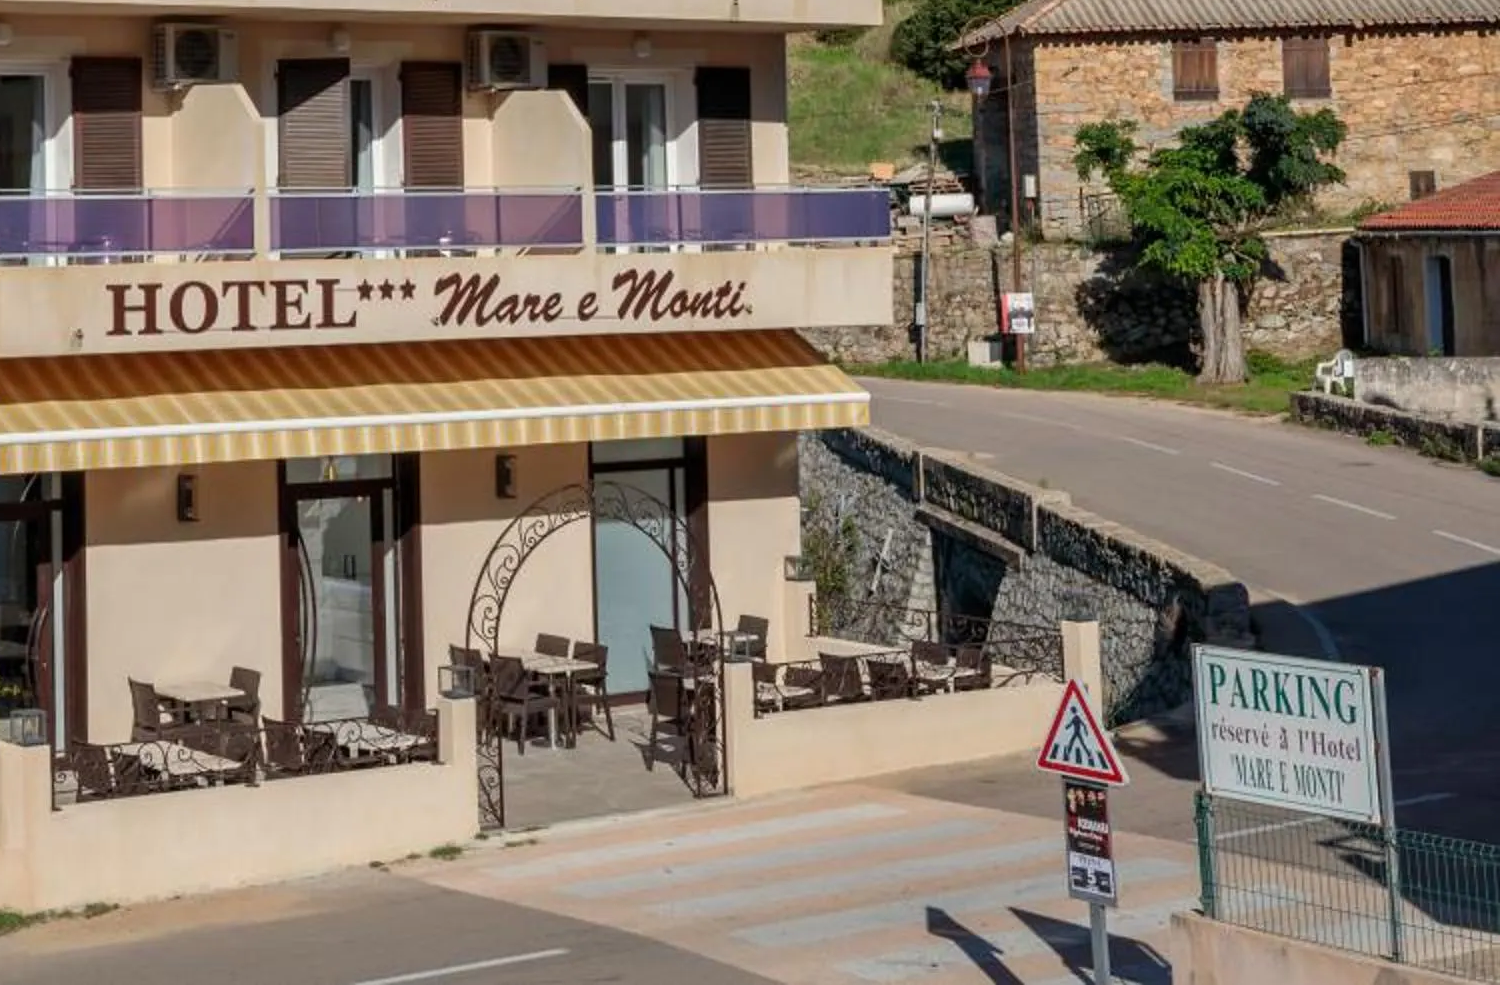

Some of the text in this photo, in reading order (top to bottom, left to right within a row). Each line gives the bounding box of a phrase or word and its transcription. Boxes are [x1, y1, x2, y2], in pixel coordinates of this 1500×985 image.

[105, 268, 747, 336] HOTEL Mare e Monti
[1207, 662, 1357, 725] PARKING
[1211, 716, 1362, 762] réservé à l'Hotel
[1279, 760, 1289, 794] E
